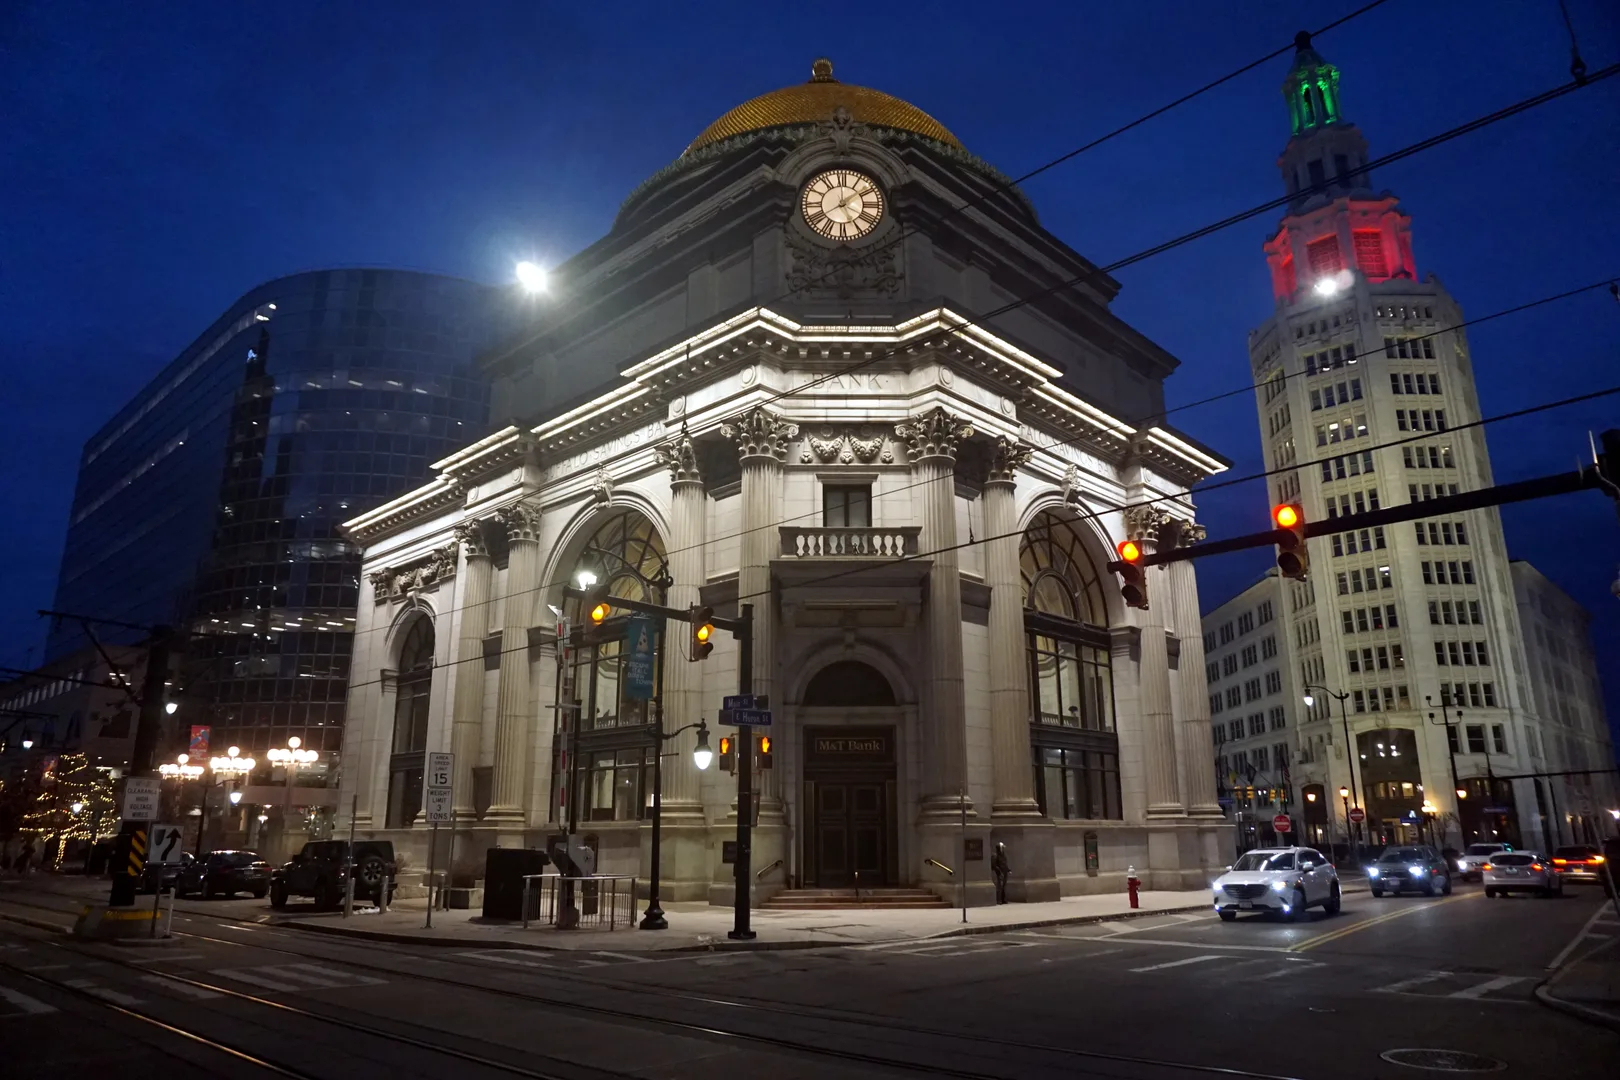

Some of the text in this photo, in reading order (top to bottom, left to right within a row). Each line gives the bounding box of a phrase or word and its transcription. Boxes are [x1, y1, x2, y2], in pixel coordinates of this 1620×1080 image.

[812, 372, 882, 390] BANK
[742, 711, 761, 723] Huron
[819, 740, 880, 751] M&T Bank
[434, 773, 448, 785] 15
[436, 804, 442, 812] 3
